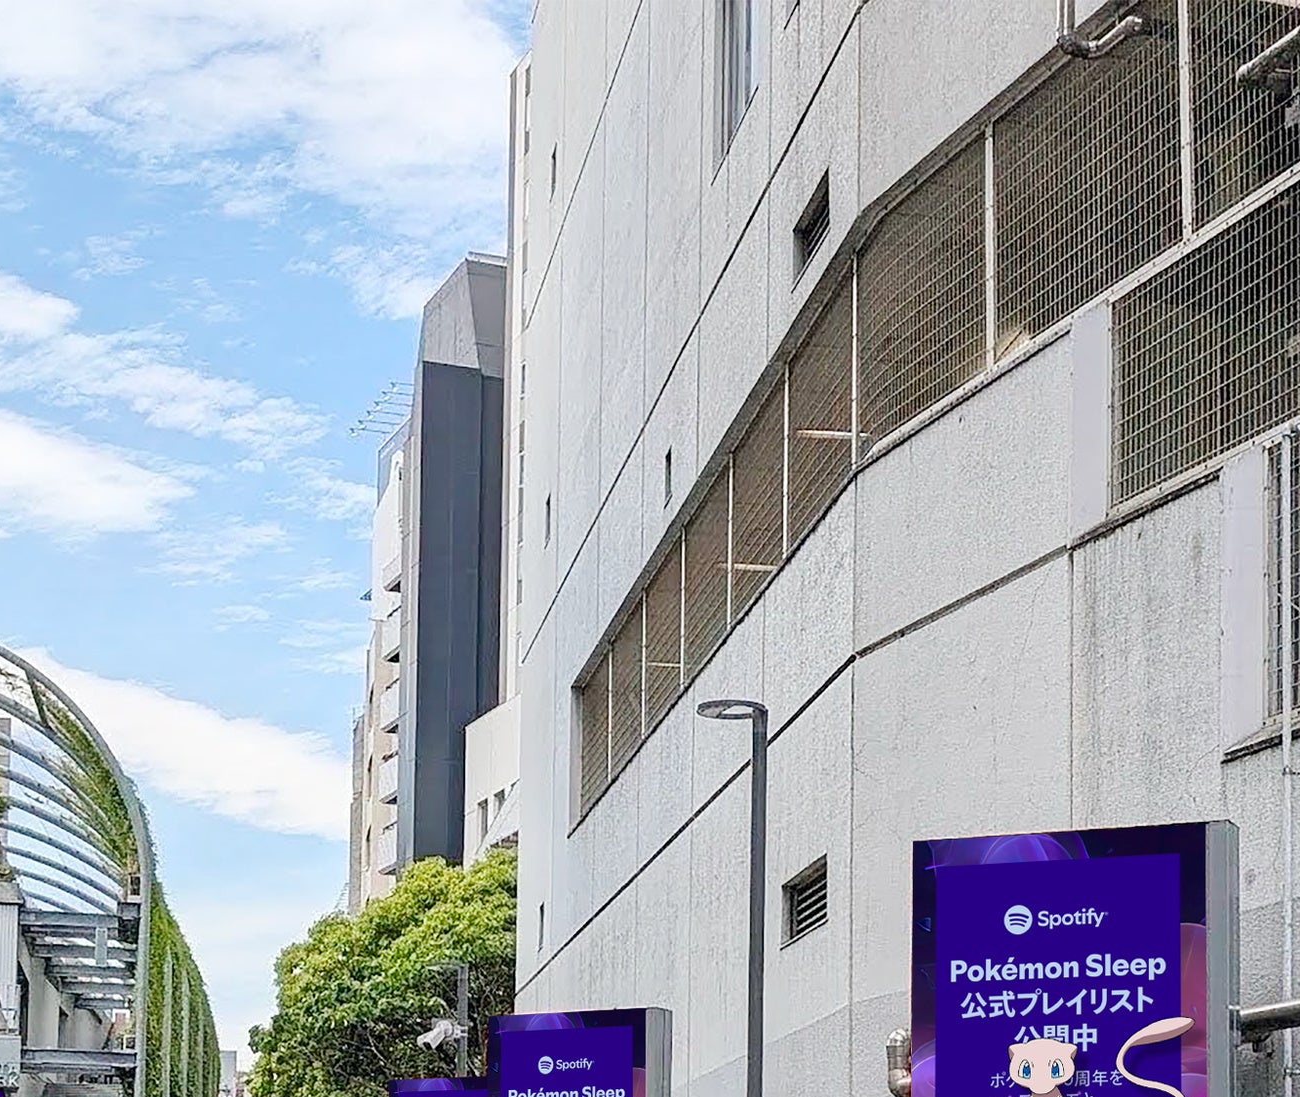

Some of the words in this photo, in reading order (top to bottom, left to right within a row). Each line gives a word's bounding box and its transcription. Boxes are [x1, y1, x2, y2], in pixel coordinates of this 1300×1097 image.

[1038, 908, 1104, 929] Spotify
[951, 957, 1079, 982] Pokémon
[1086, 954, 1166, 980] Sleep
[961, 987, 1153, 1018] 公式プレイリスト
[556, 1058, 592, 1071] Spotify
